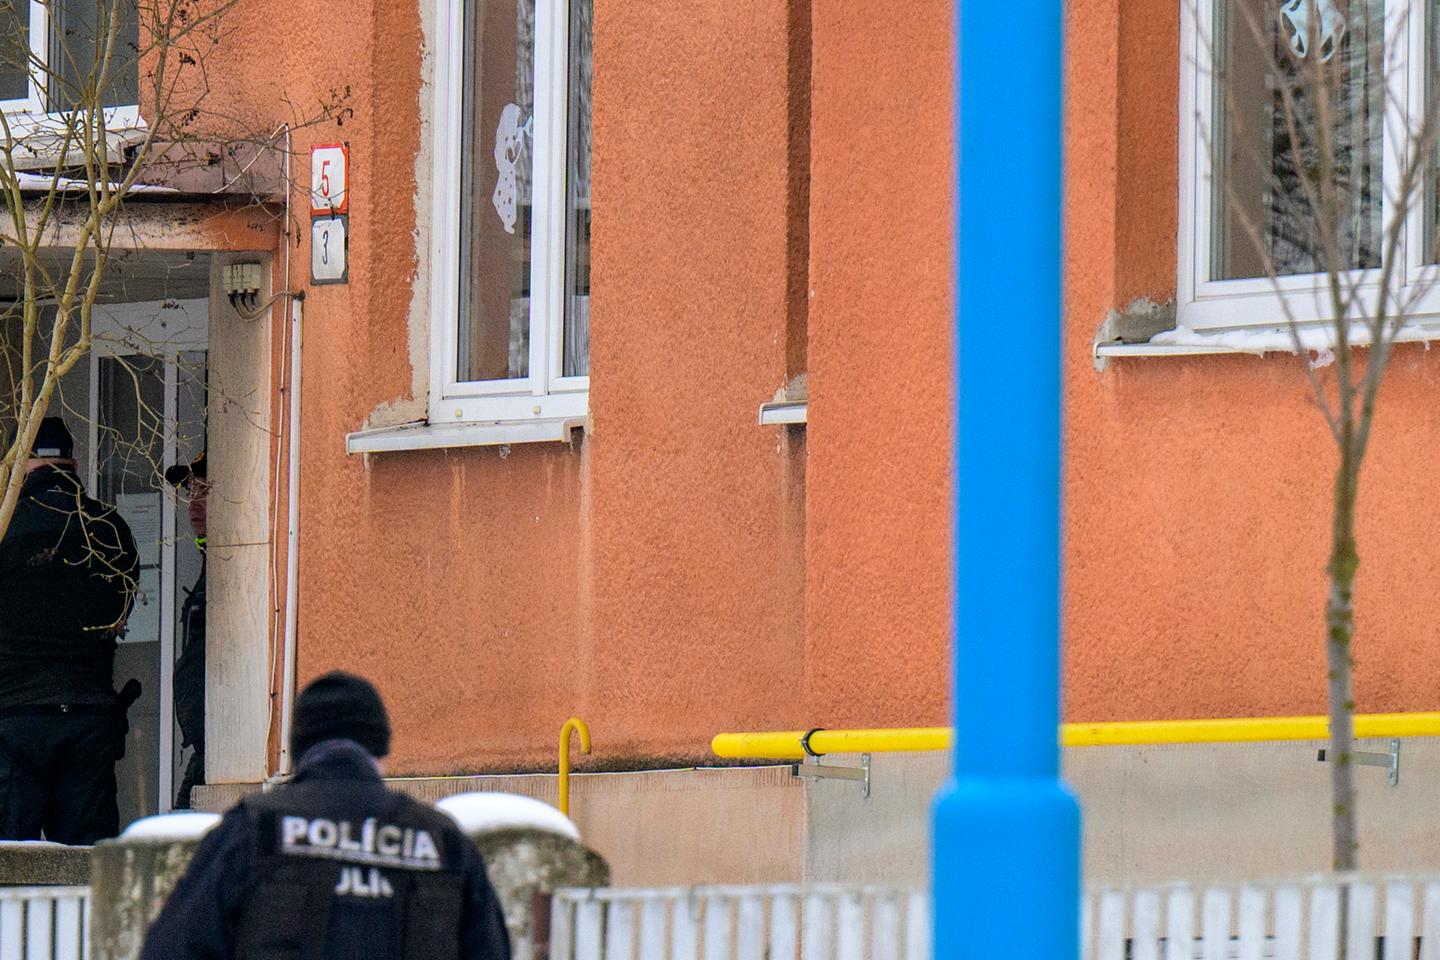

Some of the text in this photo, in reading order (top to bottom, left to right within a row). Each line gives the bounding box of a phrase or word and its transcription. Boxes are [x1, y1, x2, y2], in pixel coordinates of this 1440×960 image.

[321, 160, 330, 197] 5
[322, 230, 329, 265] 3
[281, 815, 441, 860] POLÍCIA
